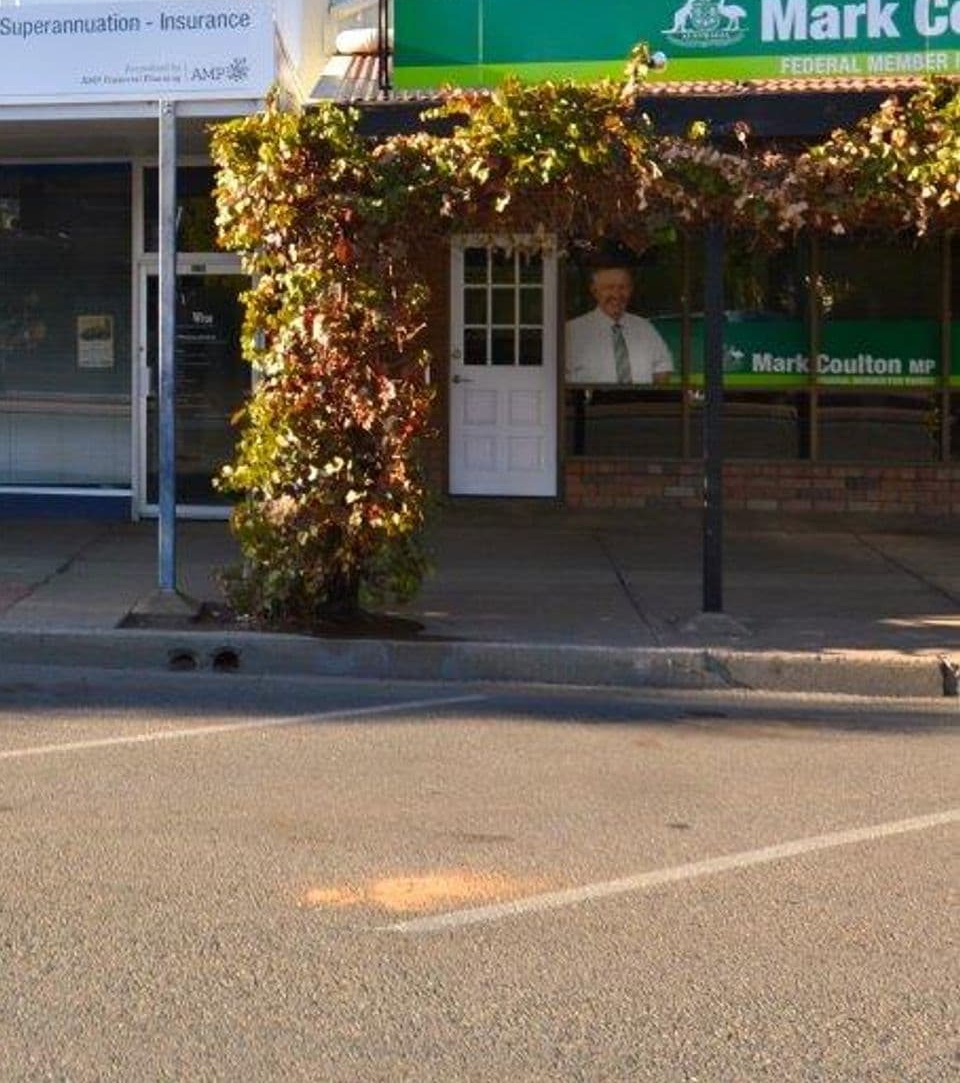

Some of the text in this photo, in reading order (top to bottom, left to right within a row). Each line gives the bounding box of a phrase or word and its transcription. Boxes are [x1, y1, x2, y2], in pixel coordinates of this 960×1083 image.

[0, 13, 140, 40] Superannuation
[160, 11, 251, 31] Insurance
[190, 67, 226, 82] AMP
[780, 54, 860, 75] FEDERAL
[865, 52, 949, 73] MEMBER
[751, 352, 936, 375] Mark Coulton MP
